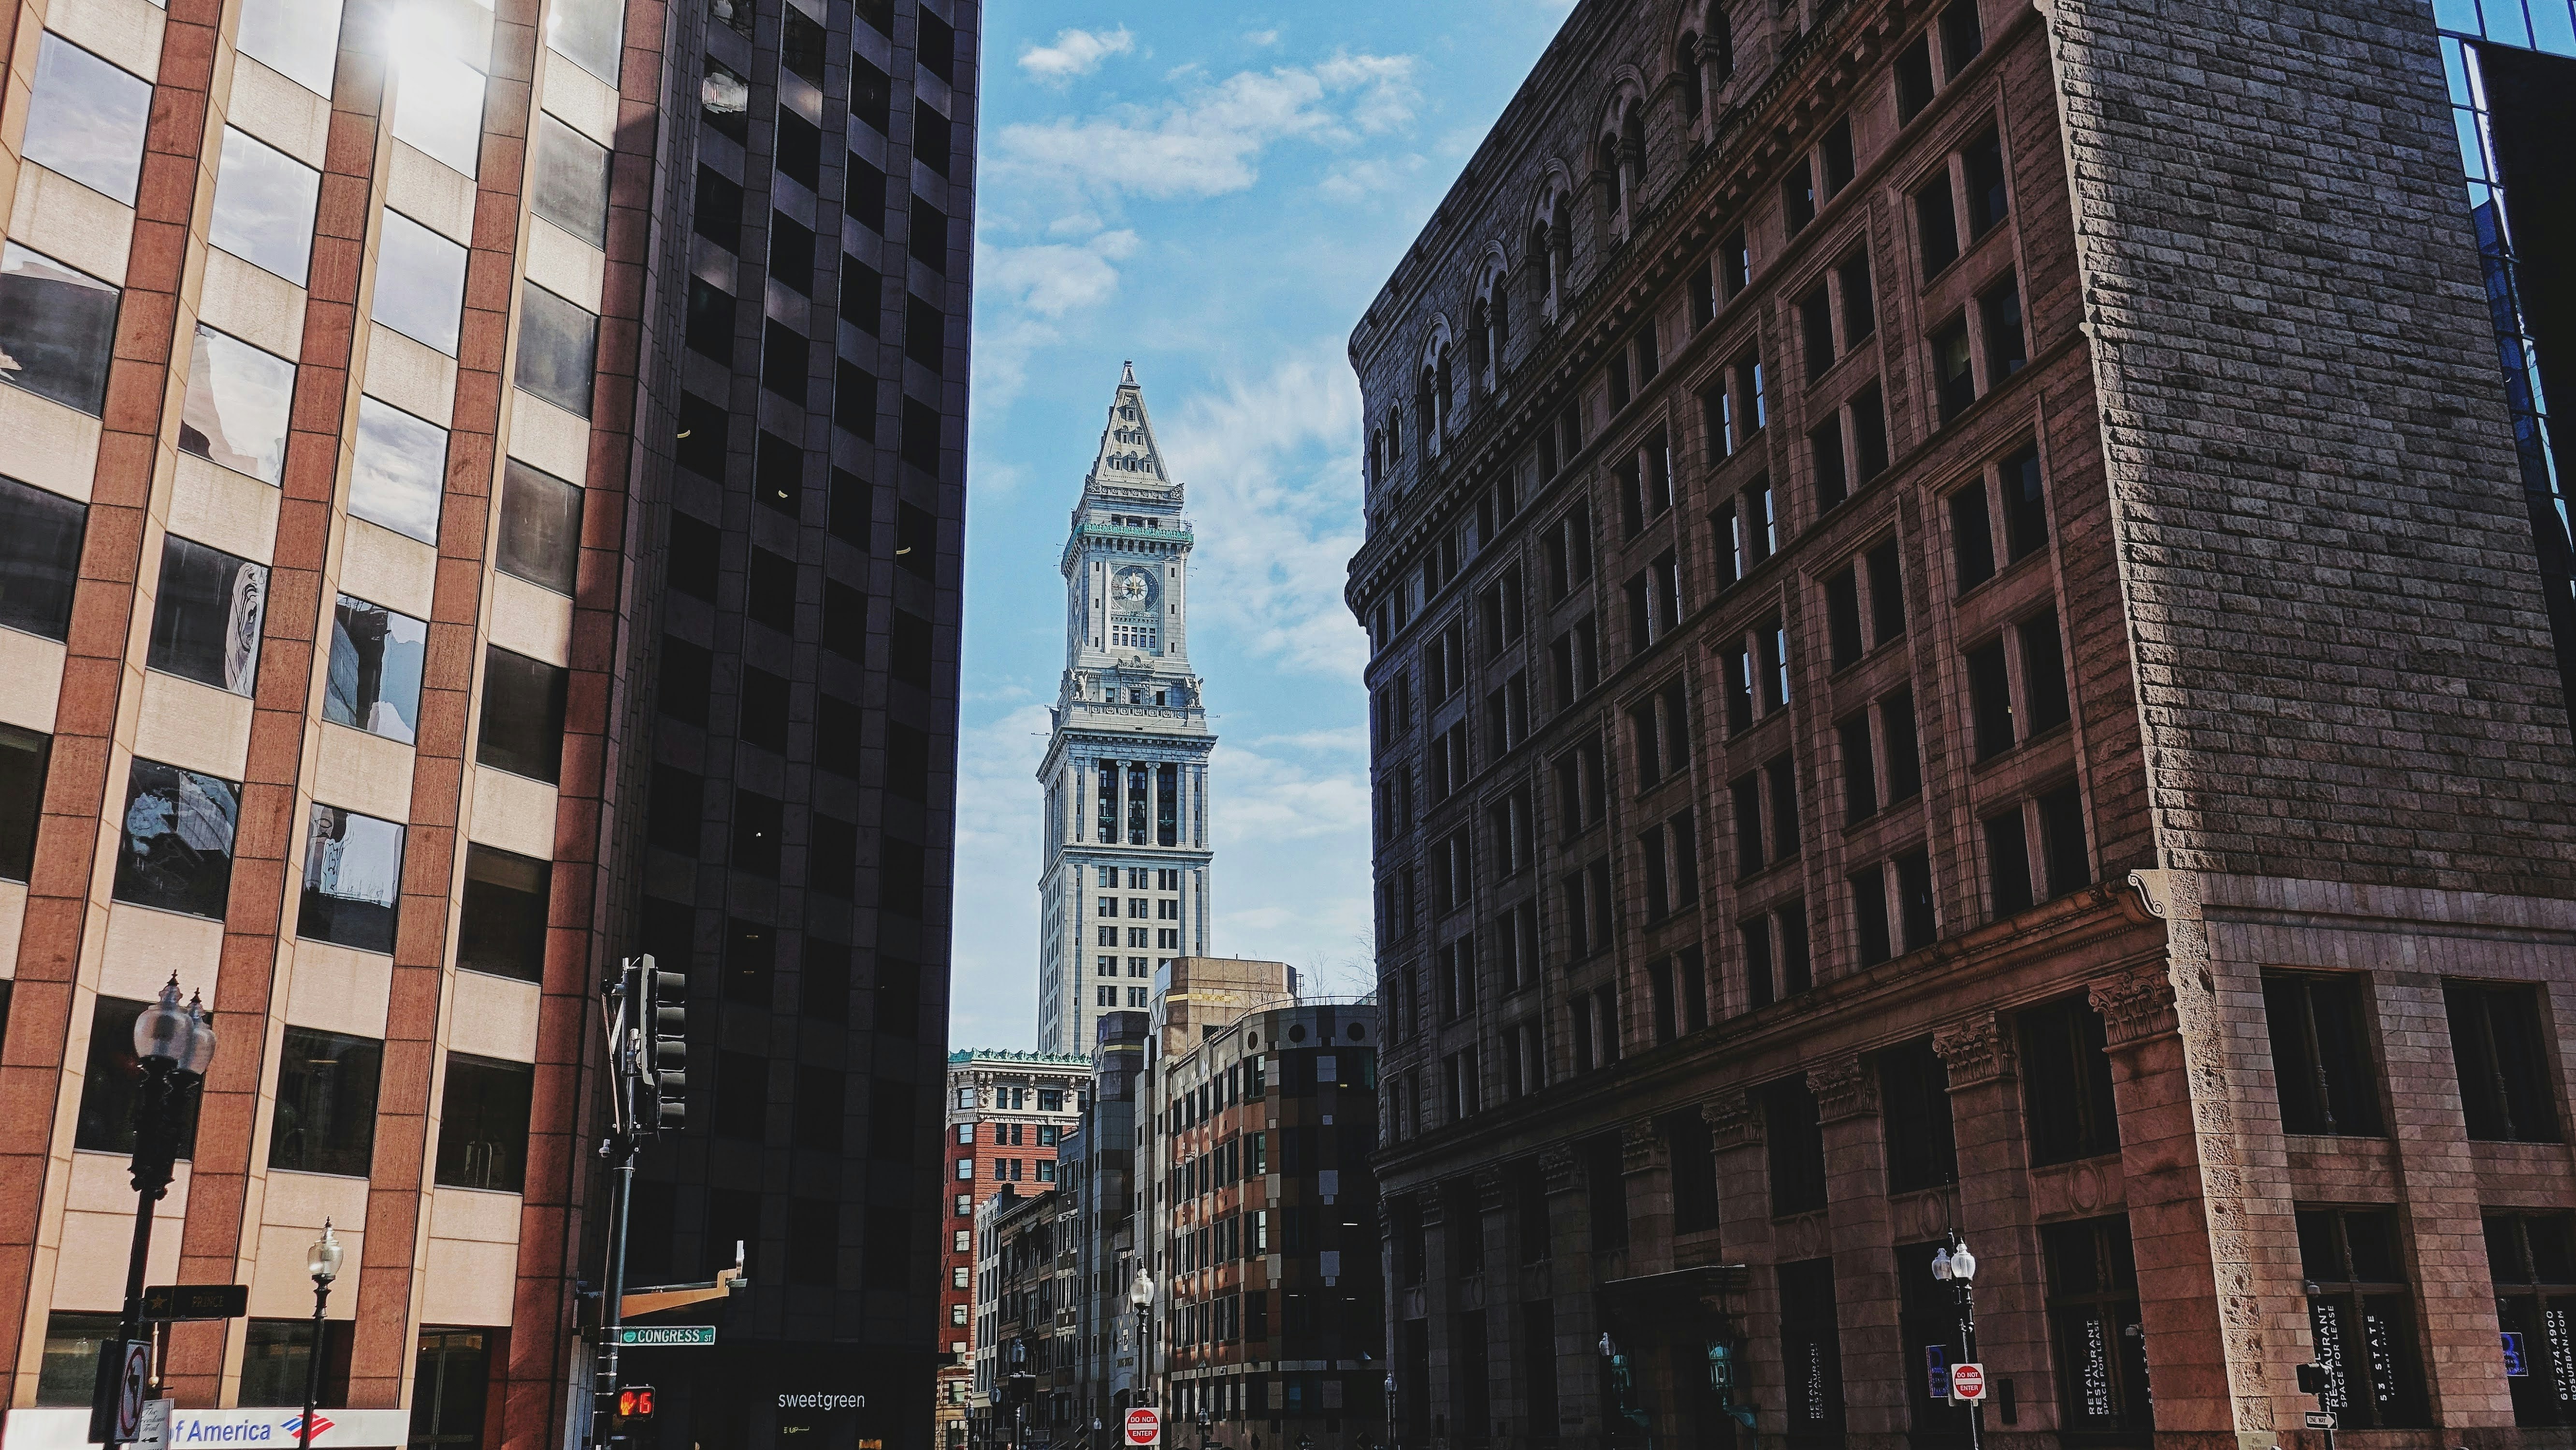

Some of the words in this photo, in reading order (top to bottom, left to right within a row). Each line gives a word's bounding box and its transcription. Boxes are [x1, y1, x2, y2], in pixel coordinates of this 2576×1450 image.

[637, 1329, 700, 1343] CONGRESS
[2093, 1320, 2102, 1352] LEASE
[2327, 1305, 2338, 1339] LEASE
[2333, 1344, 2342, 1367] FOR
[2367, 1315, 2382, 1370] STATE
[1810, 1342, 1821, 1419] RESTAURANT
[2086, 1320, 2103, 1415] RESTAURANT
[778, 1392, 865, 1411] sweetgreen
[2084, 1365, 2095, 1415] RETAIL
[2101, 1381, 2110, 1416] SPACE
[2337, 1371, 2348, 1407] SPACE
[187, 1419, 271, 1442] America
